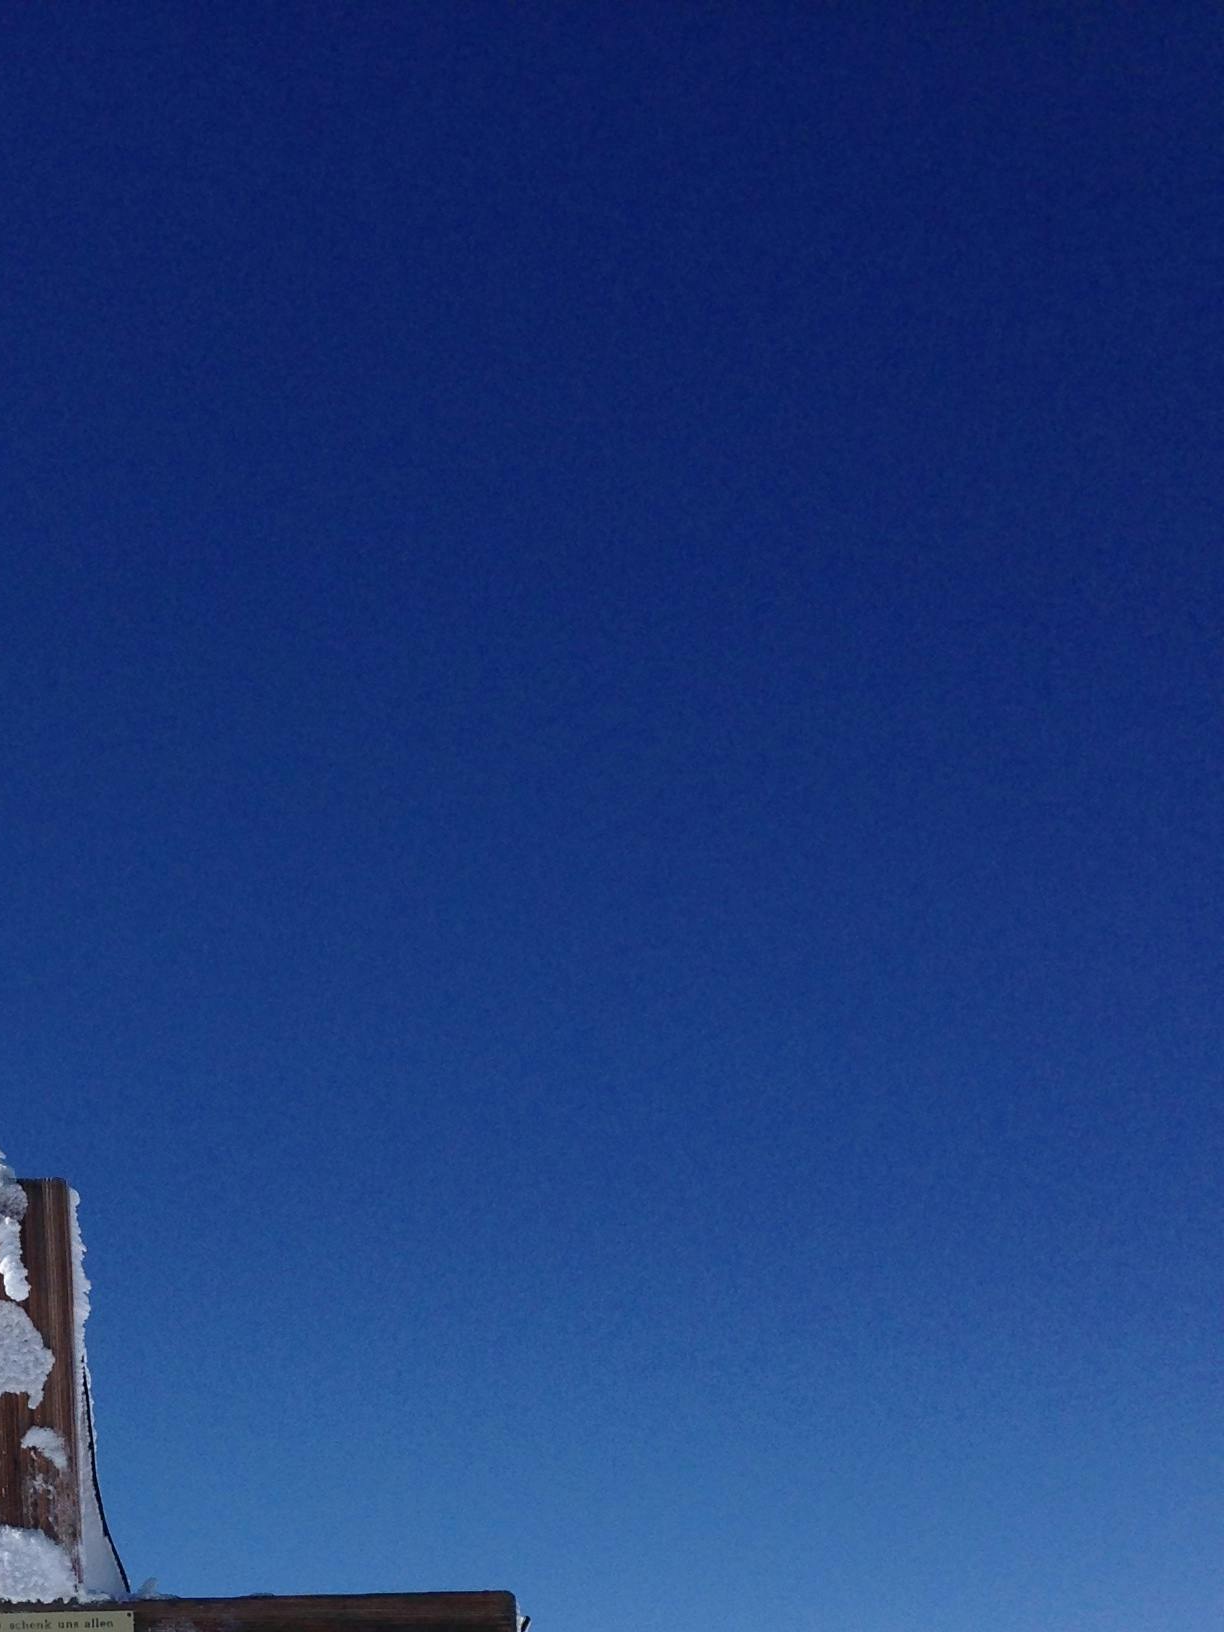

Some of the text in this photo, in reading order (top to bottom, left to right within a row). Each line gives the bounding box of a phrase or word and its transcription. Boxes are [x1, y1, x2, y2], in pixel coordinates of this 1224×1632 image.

[9, 1619, 52, 1630] schenk
[58, 1620, 79, 1629] uns
[84, 1617, 114, 1628] allen
